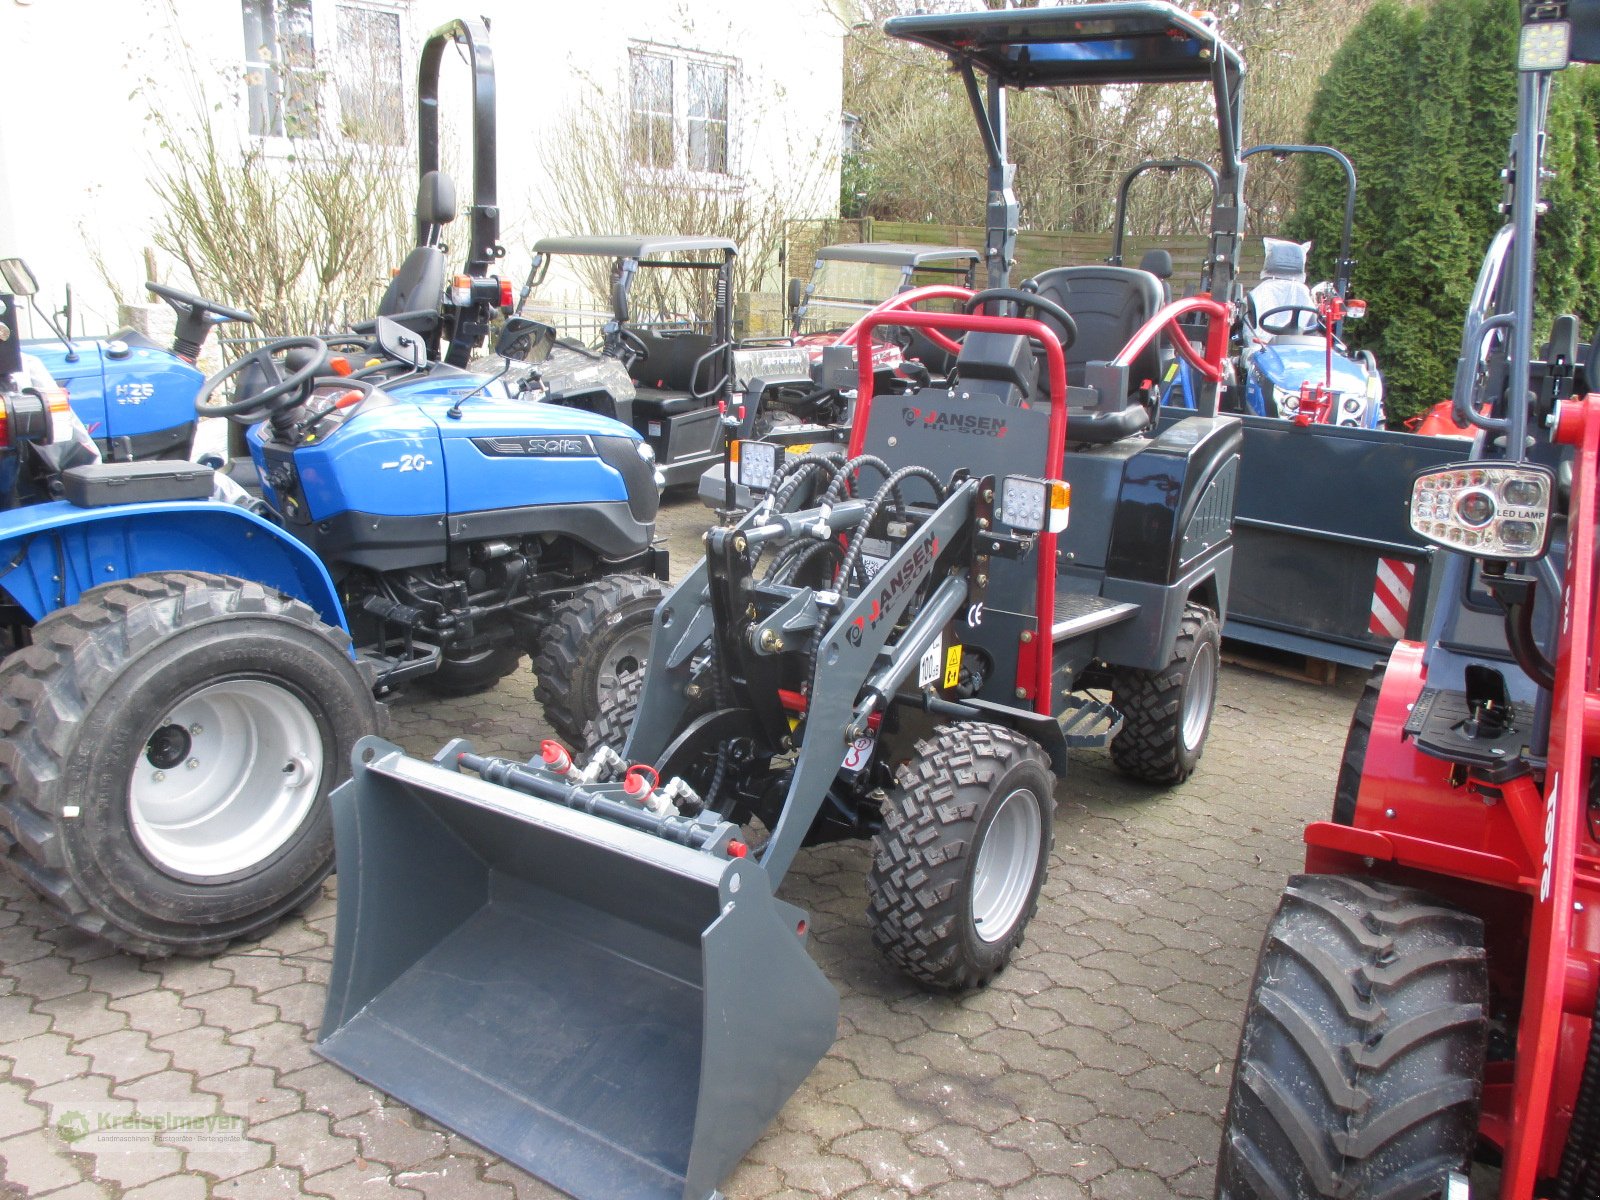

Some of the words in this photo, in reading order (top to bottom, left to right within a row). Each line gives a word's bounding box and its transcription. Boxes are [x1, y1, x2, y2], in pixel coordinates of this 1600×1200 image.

[923, 409, 1006, 430] JANSEN
[1496, 509, 1516, 518] LED
[1518, 510, 1545, 520] LAMP
[868, 531, 936, 623] JANSEN
[967, 601, 984, 628] CE
